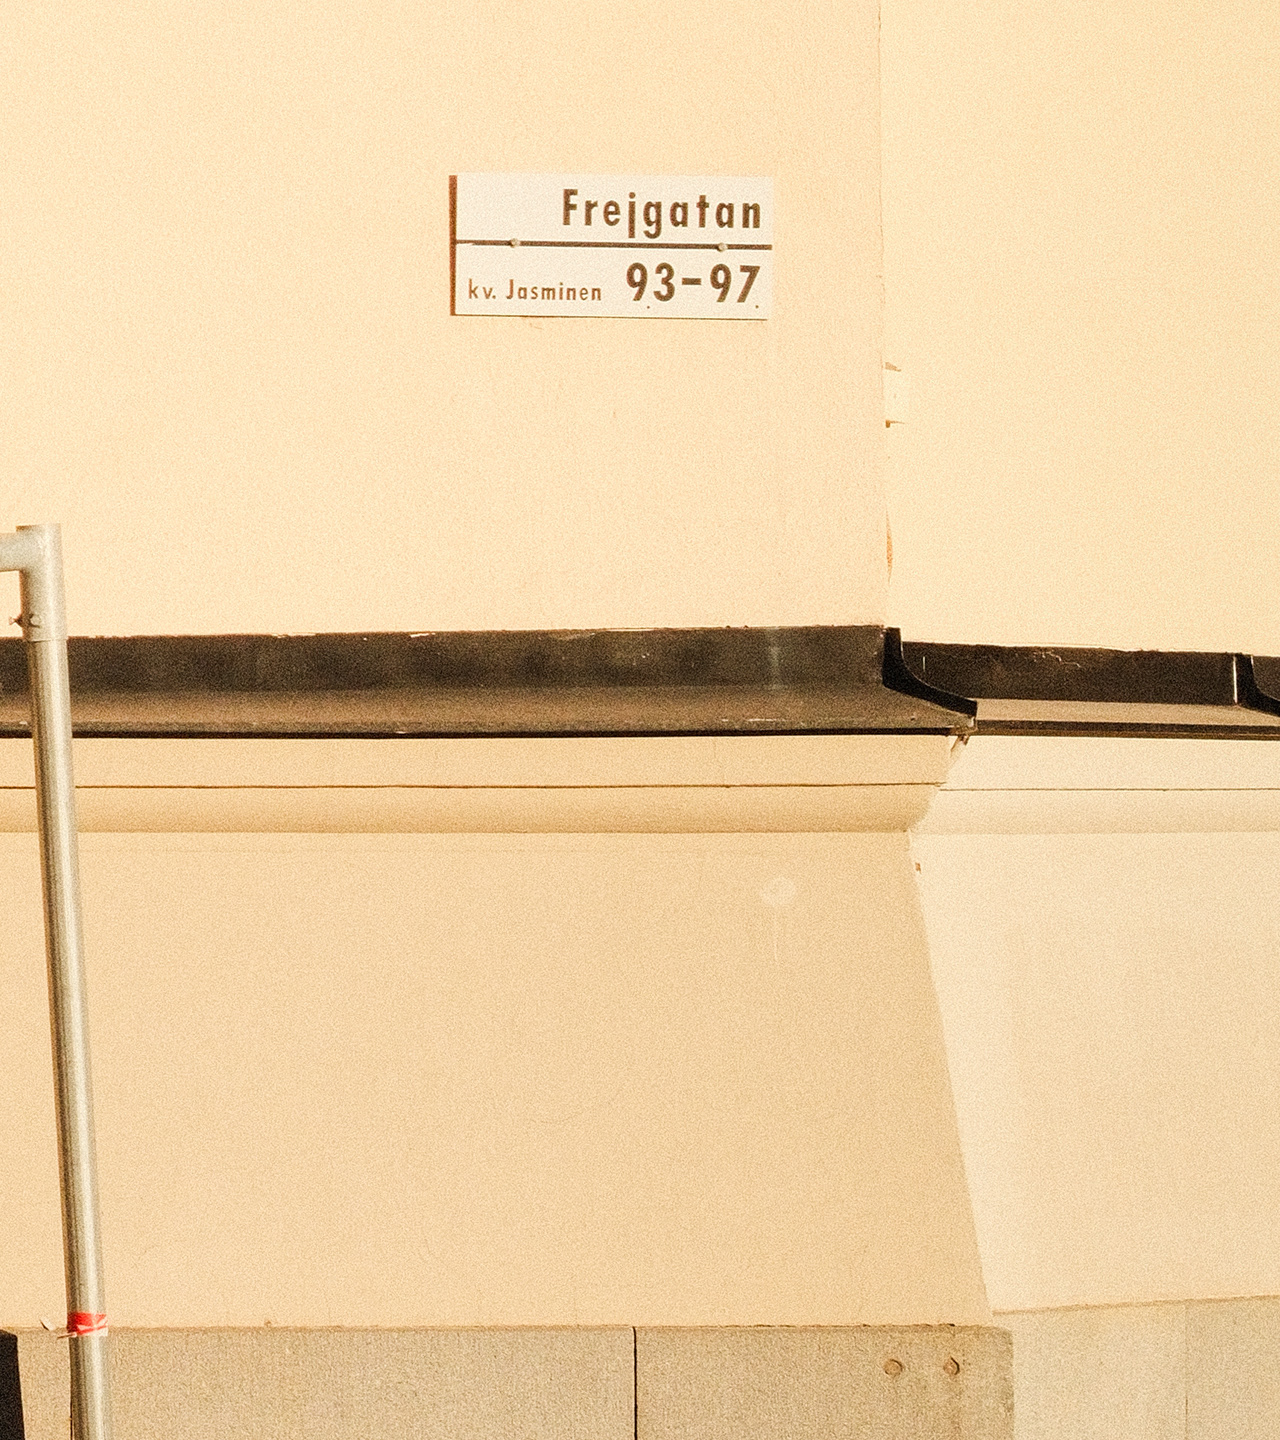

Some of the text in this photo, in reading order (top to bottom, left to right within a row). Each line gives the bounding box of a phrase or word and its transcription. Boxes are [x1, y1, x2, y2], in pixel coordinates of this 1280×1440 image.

[562, 188, 761, 239] Frejgatan
[467, 278, 602, 302] kv. Jasminen
[626, 262, 761, 303] 93-97
